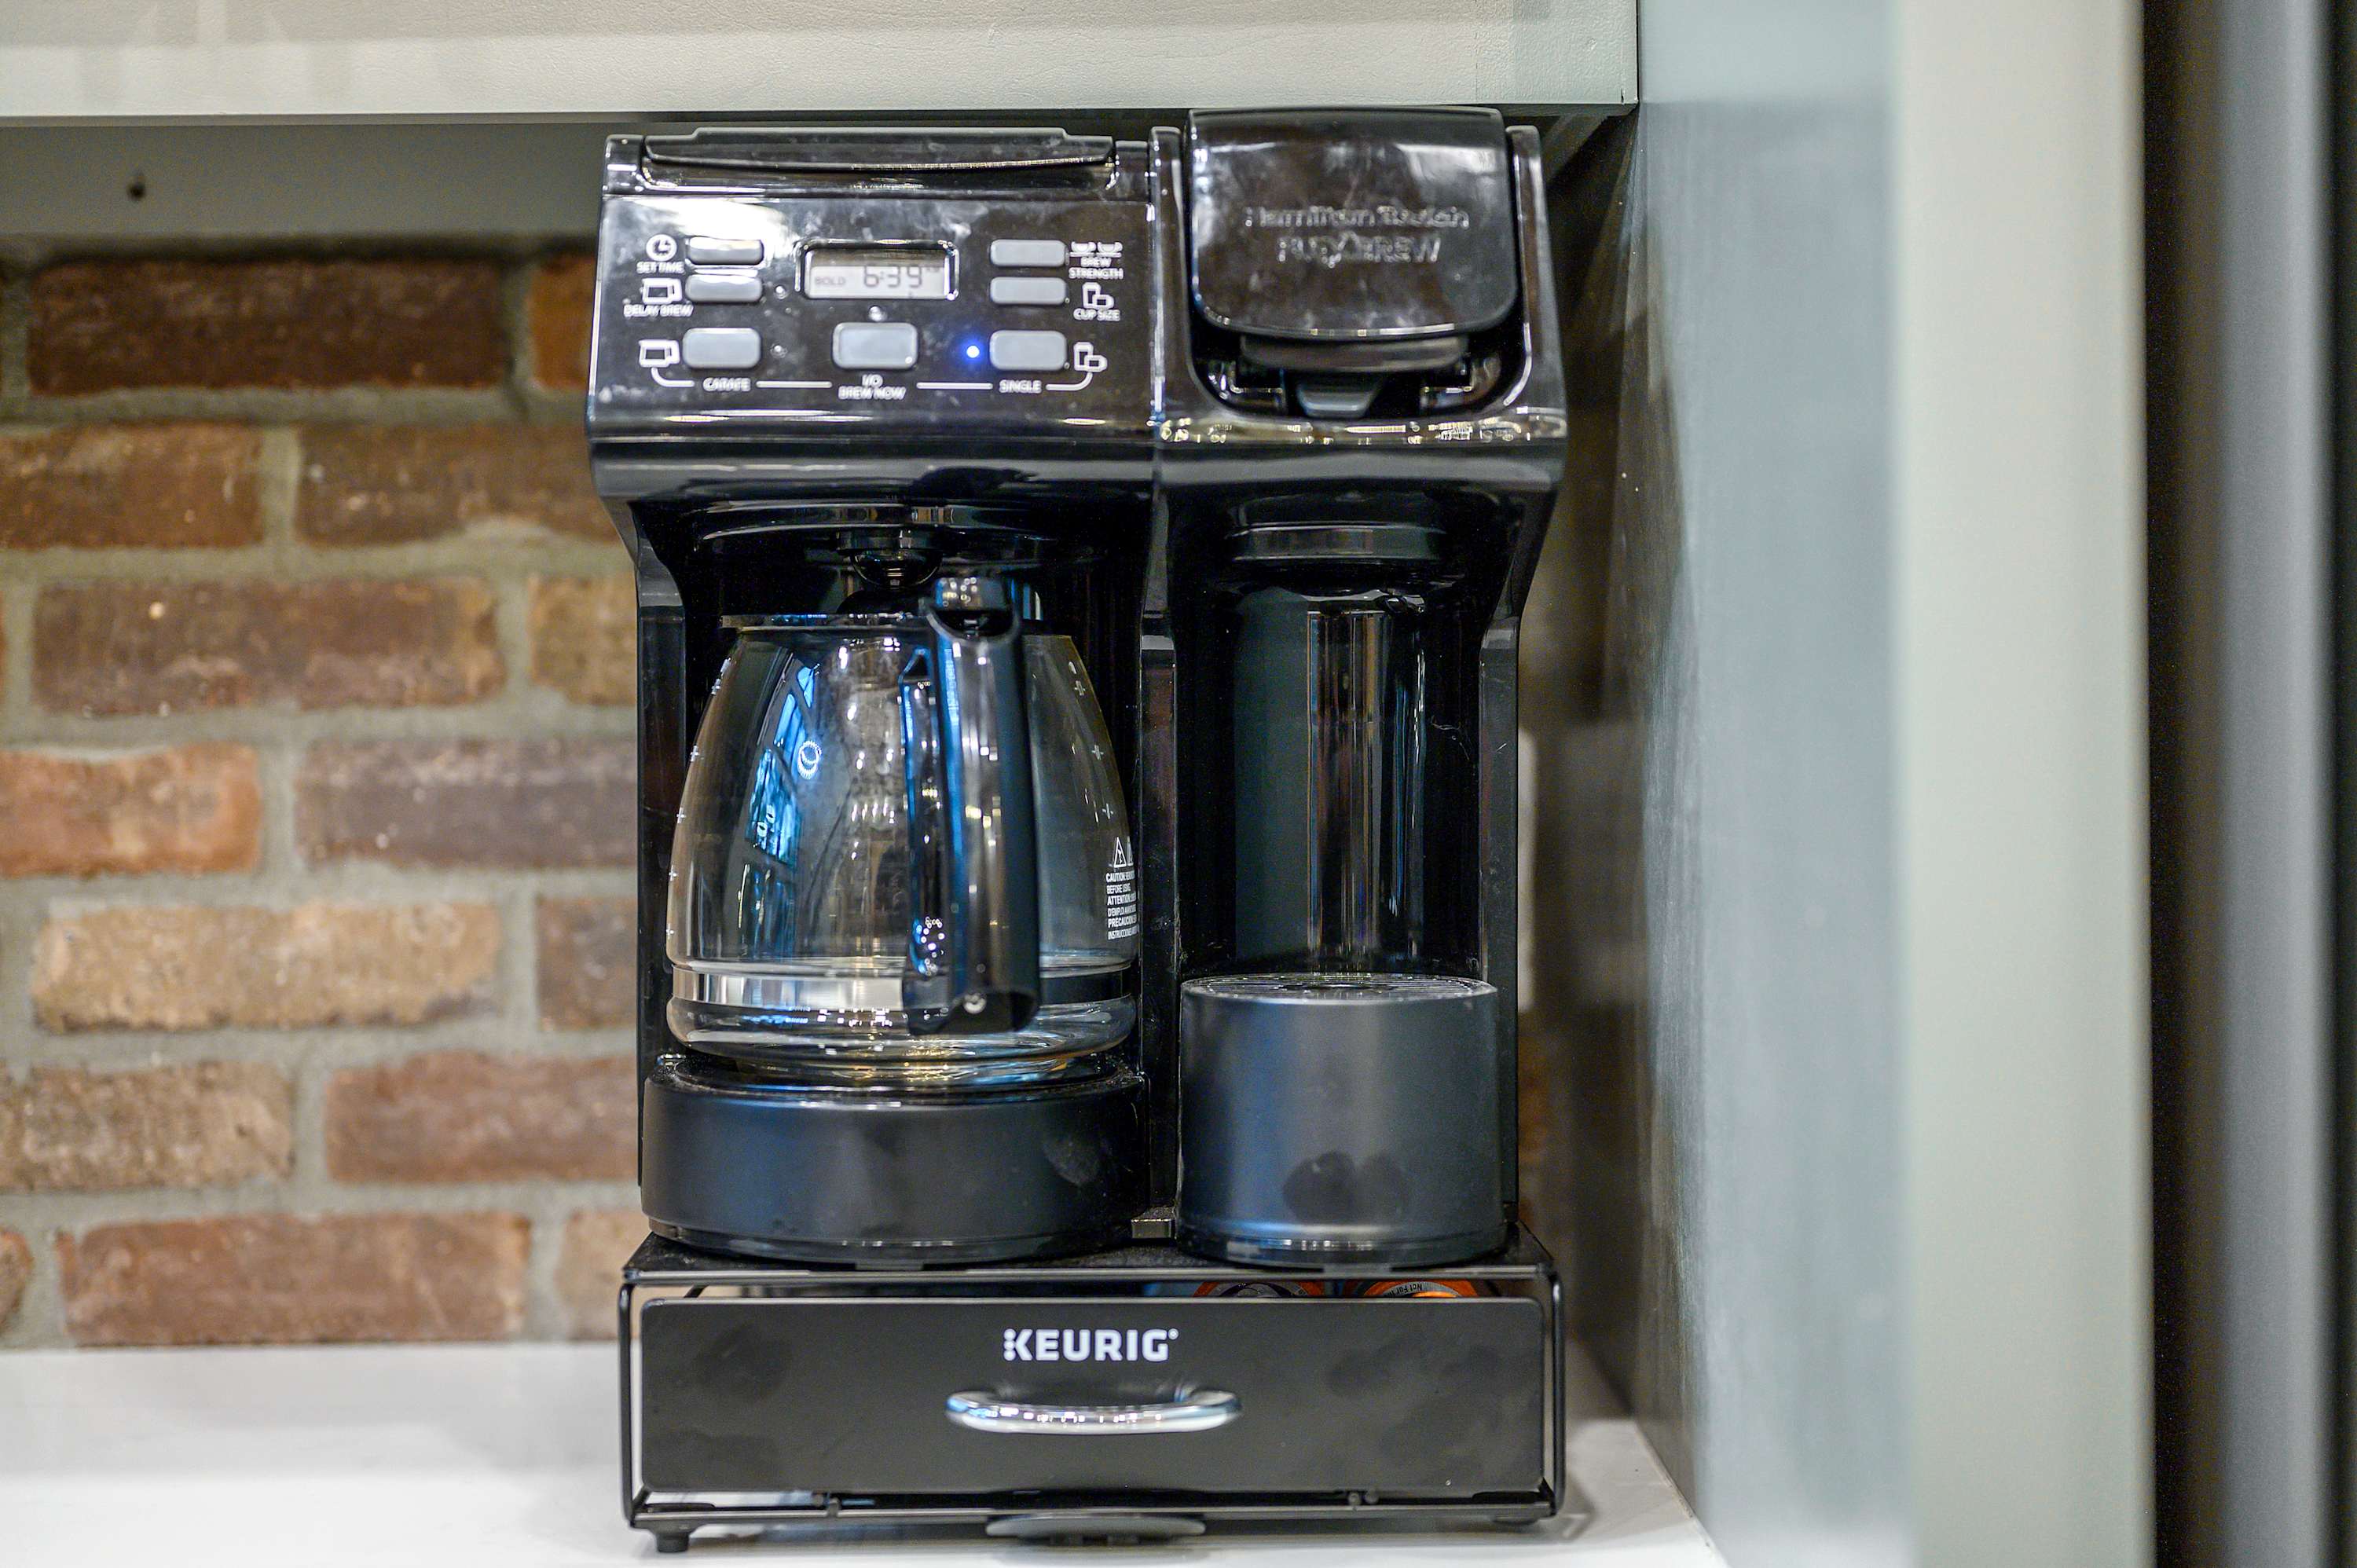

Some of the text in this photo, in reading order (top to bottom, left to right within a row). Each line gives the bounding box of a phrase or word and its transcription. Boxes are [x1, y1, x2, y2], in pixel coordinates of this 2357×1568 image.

[636, 262, 685, 274] SET TIME
[1081, 256, 1113, 268] BREW
[863, 264, 922, 288] 6:39
[1069, 267, 1124, 280] STRENGTH
[624, 304, 694, 317] DELAY BREW
[1073, 307, 1121, 321] CUP SIZE
[702, 377, 751, 392] CARAFE
[999, 379, 1043, 394] SINGLE
[838, 385, 907, 401] BREW NOW
[1003, 1328, 1171, 1361] KEURIG
